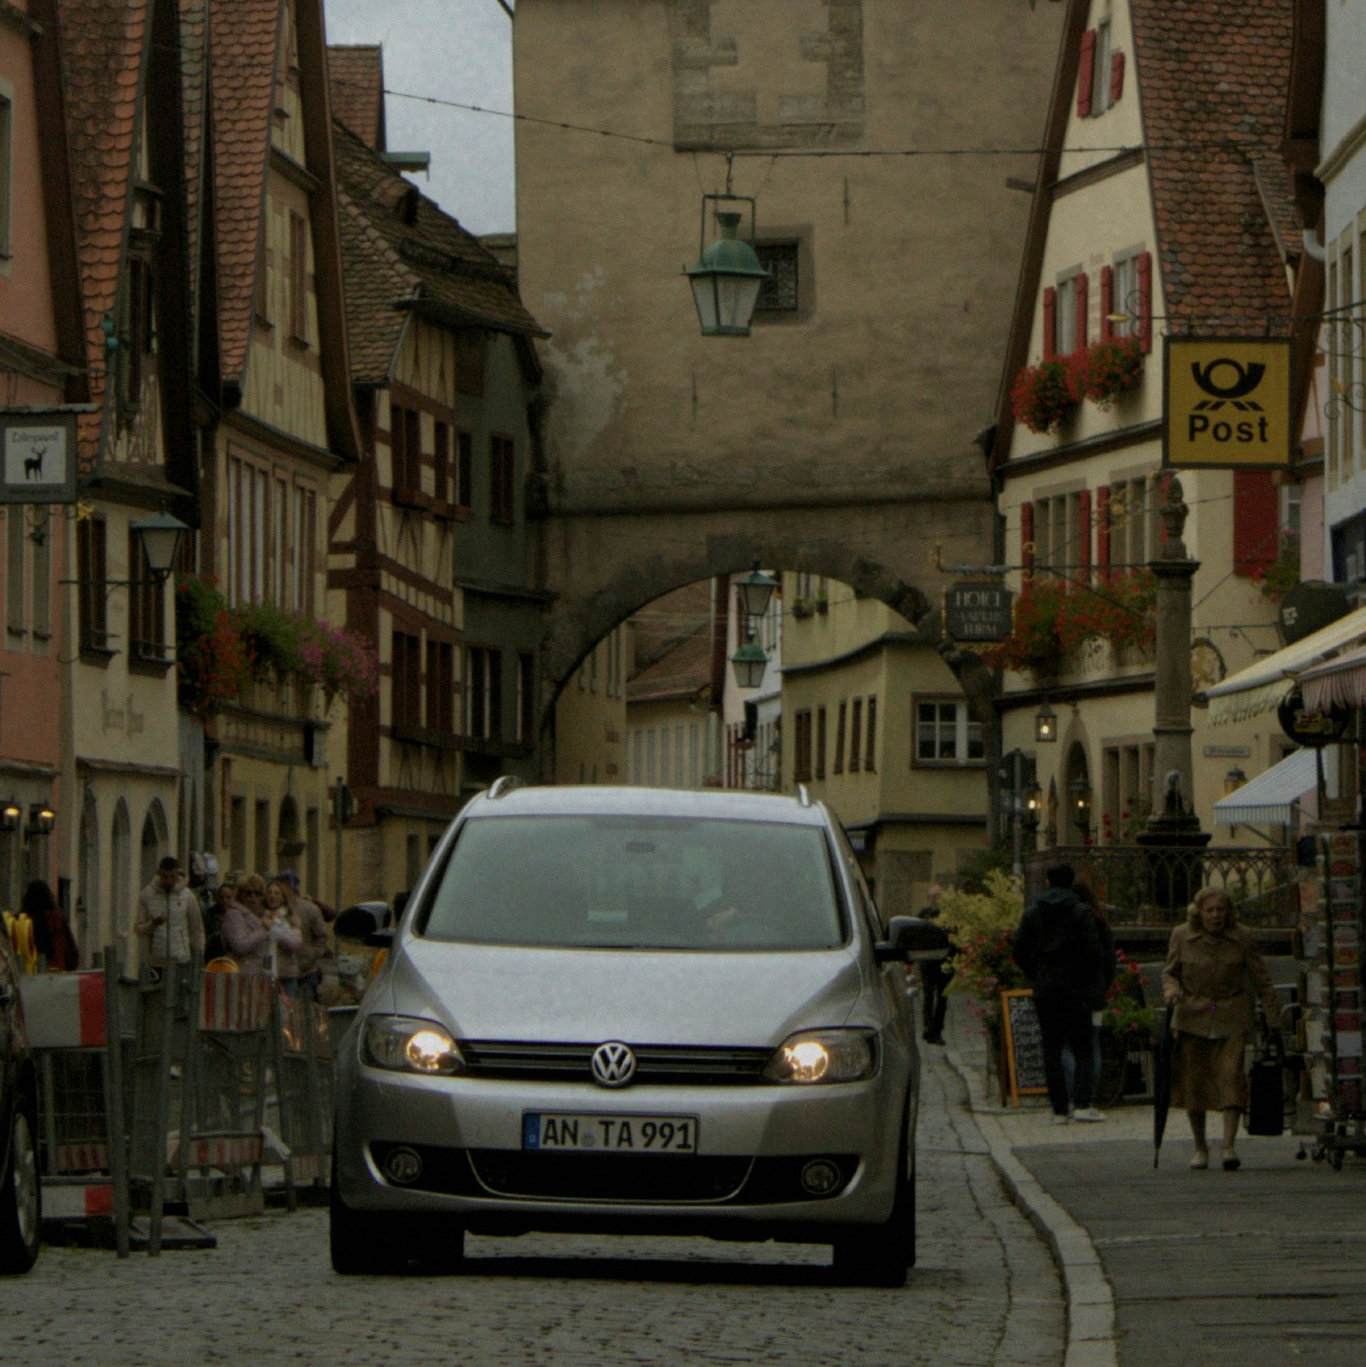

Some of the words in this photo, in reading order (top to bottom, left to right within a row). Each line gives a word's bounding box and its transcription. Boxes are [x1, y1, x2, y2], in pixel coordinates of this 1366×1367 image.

[1189, 415, 1268, 443] Post
[542, 1119, 578, 1146] AN
[598, 1120, 633, 1148] TA
[641, 1122, 692, 1150] 991
